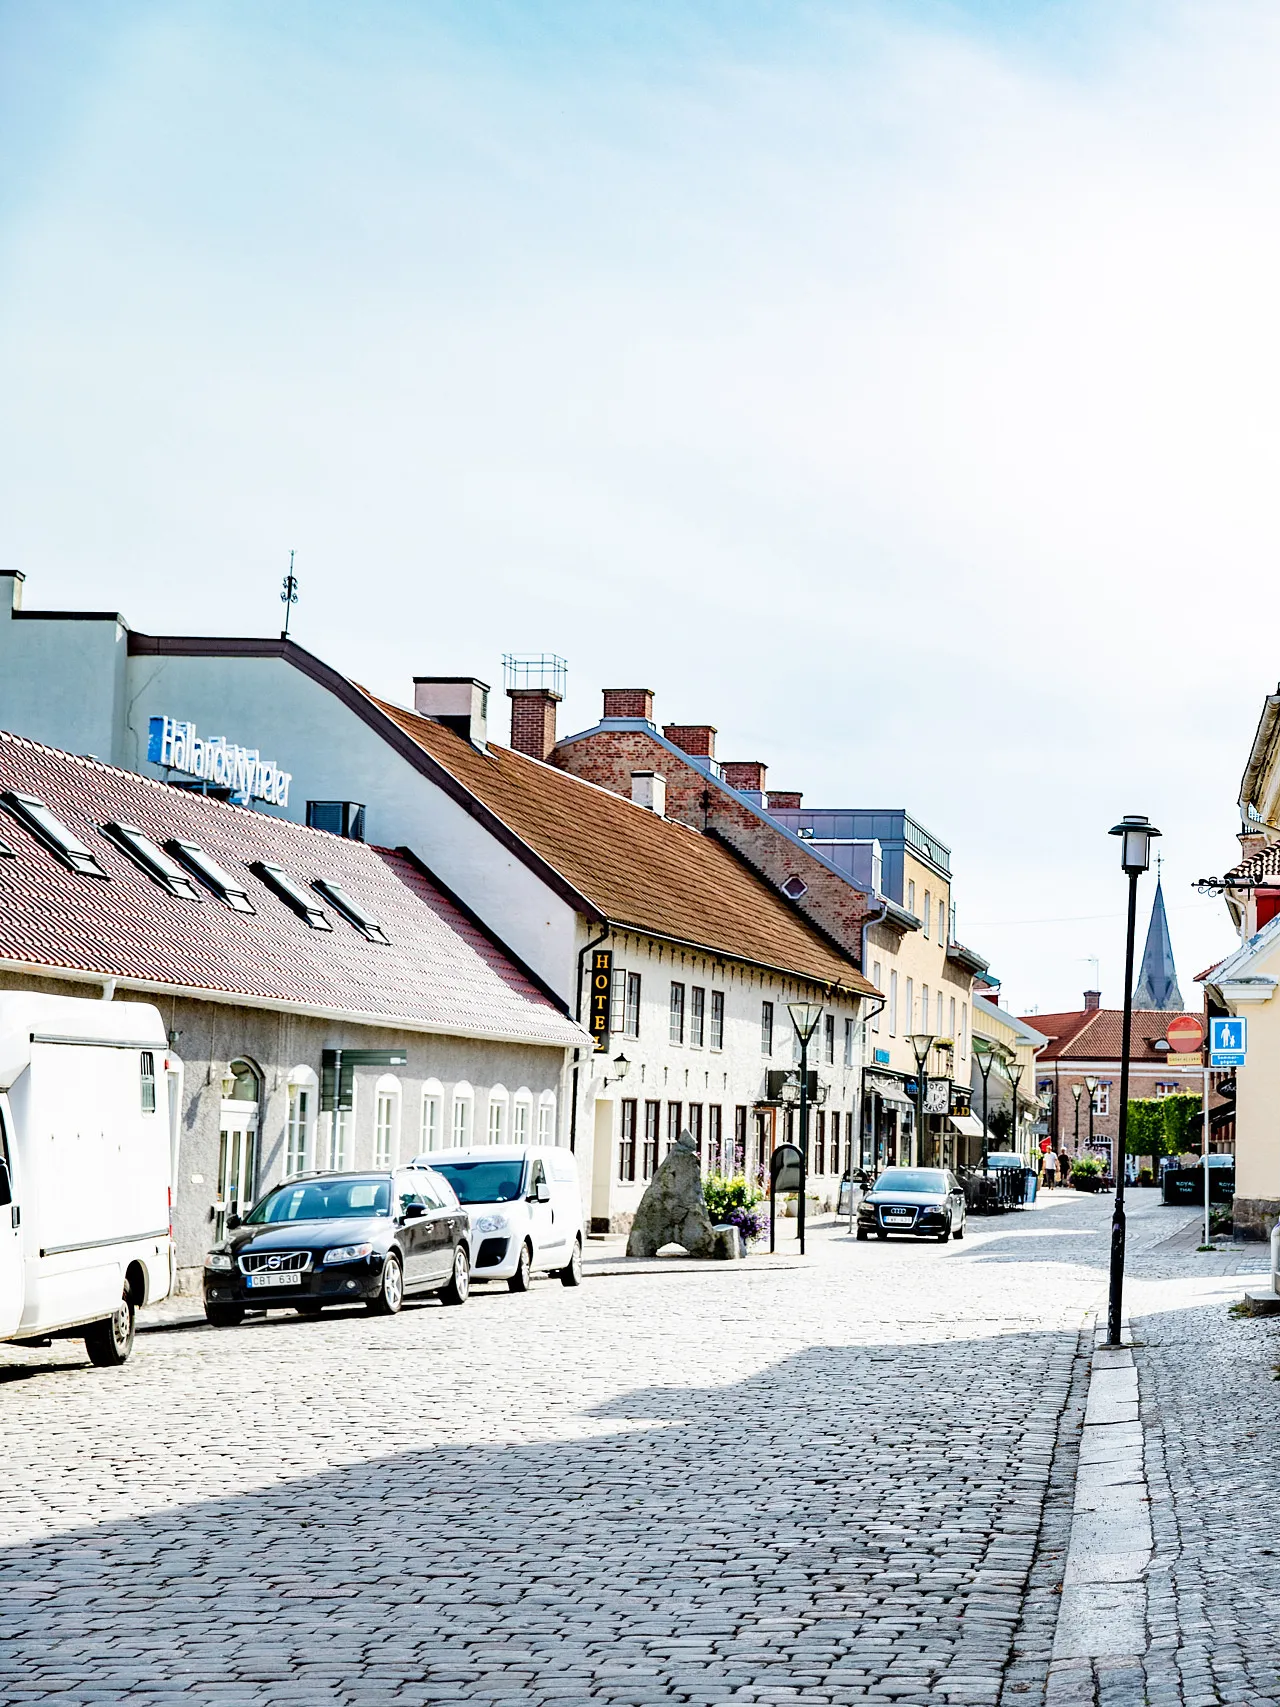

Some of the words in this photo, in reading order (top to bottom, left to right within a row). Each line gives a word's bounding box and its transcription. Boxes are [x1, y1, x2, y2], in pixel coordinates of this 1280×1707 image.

[594, 954, 609, 1050] HOTEL
[253, 1276, 271, 1285] CBT
[279, 1275, 298, 1284] 630
